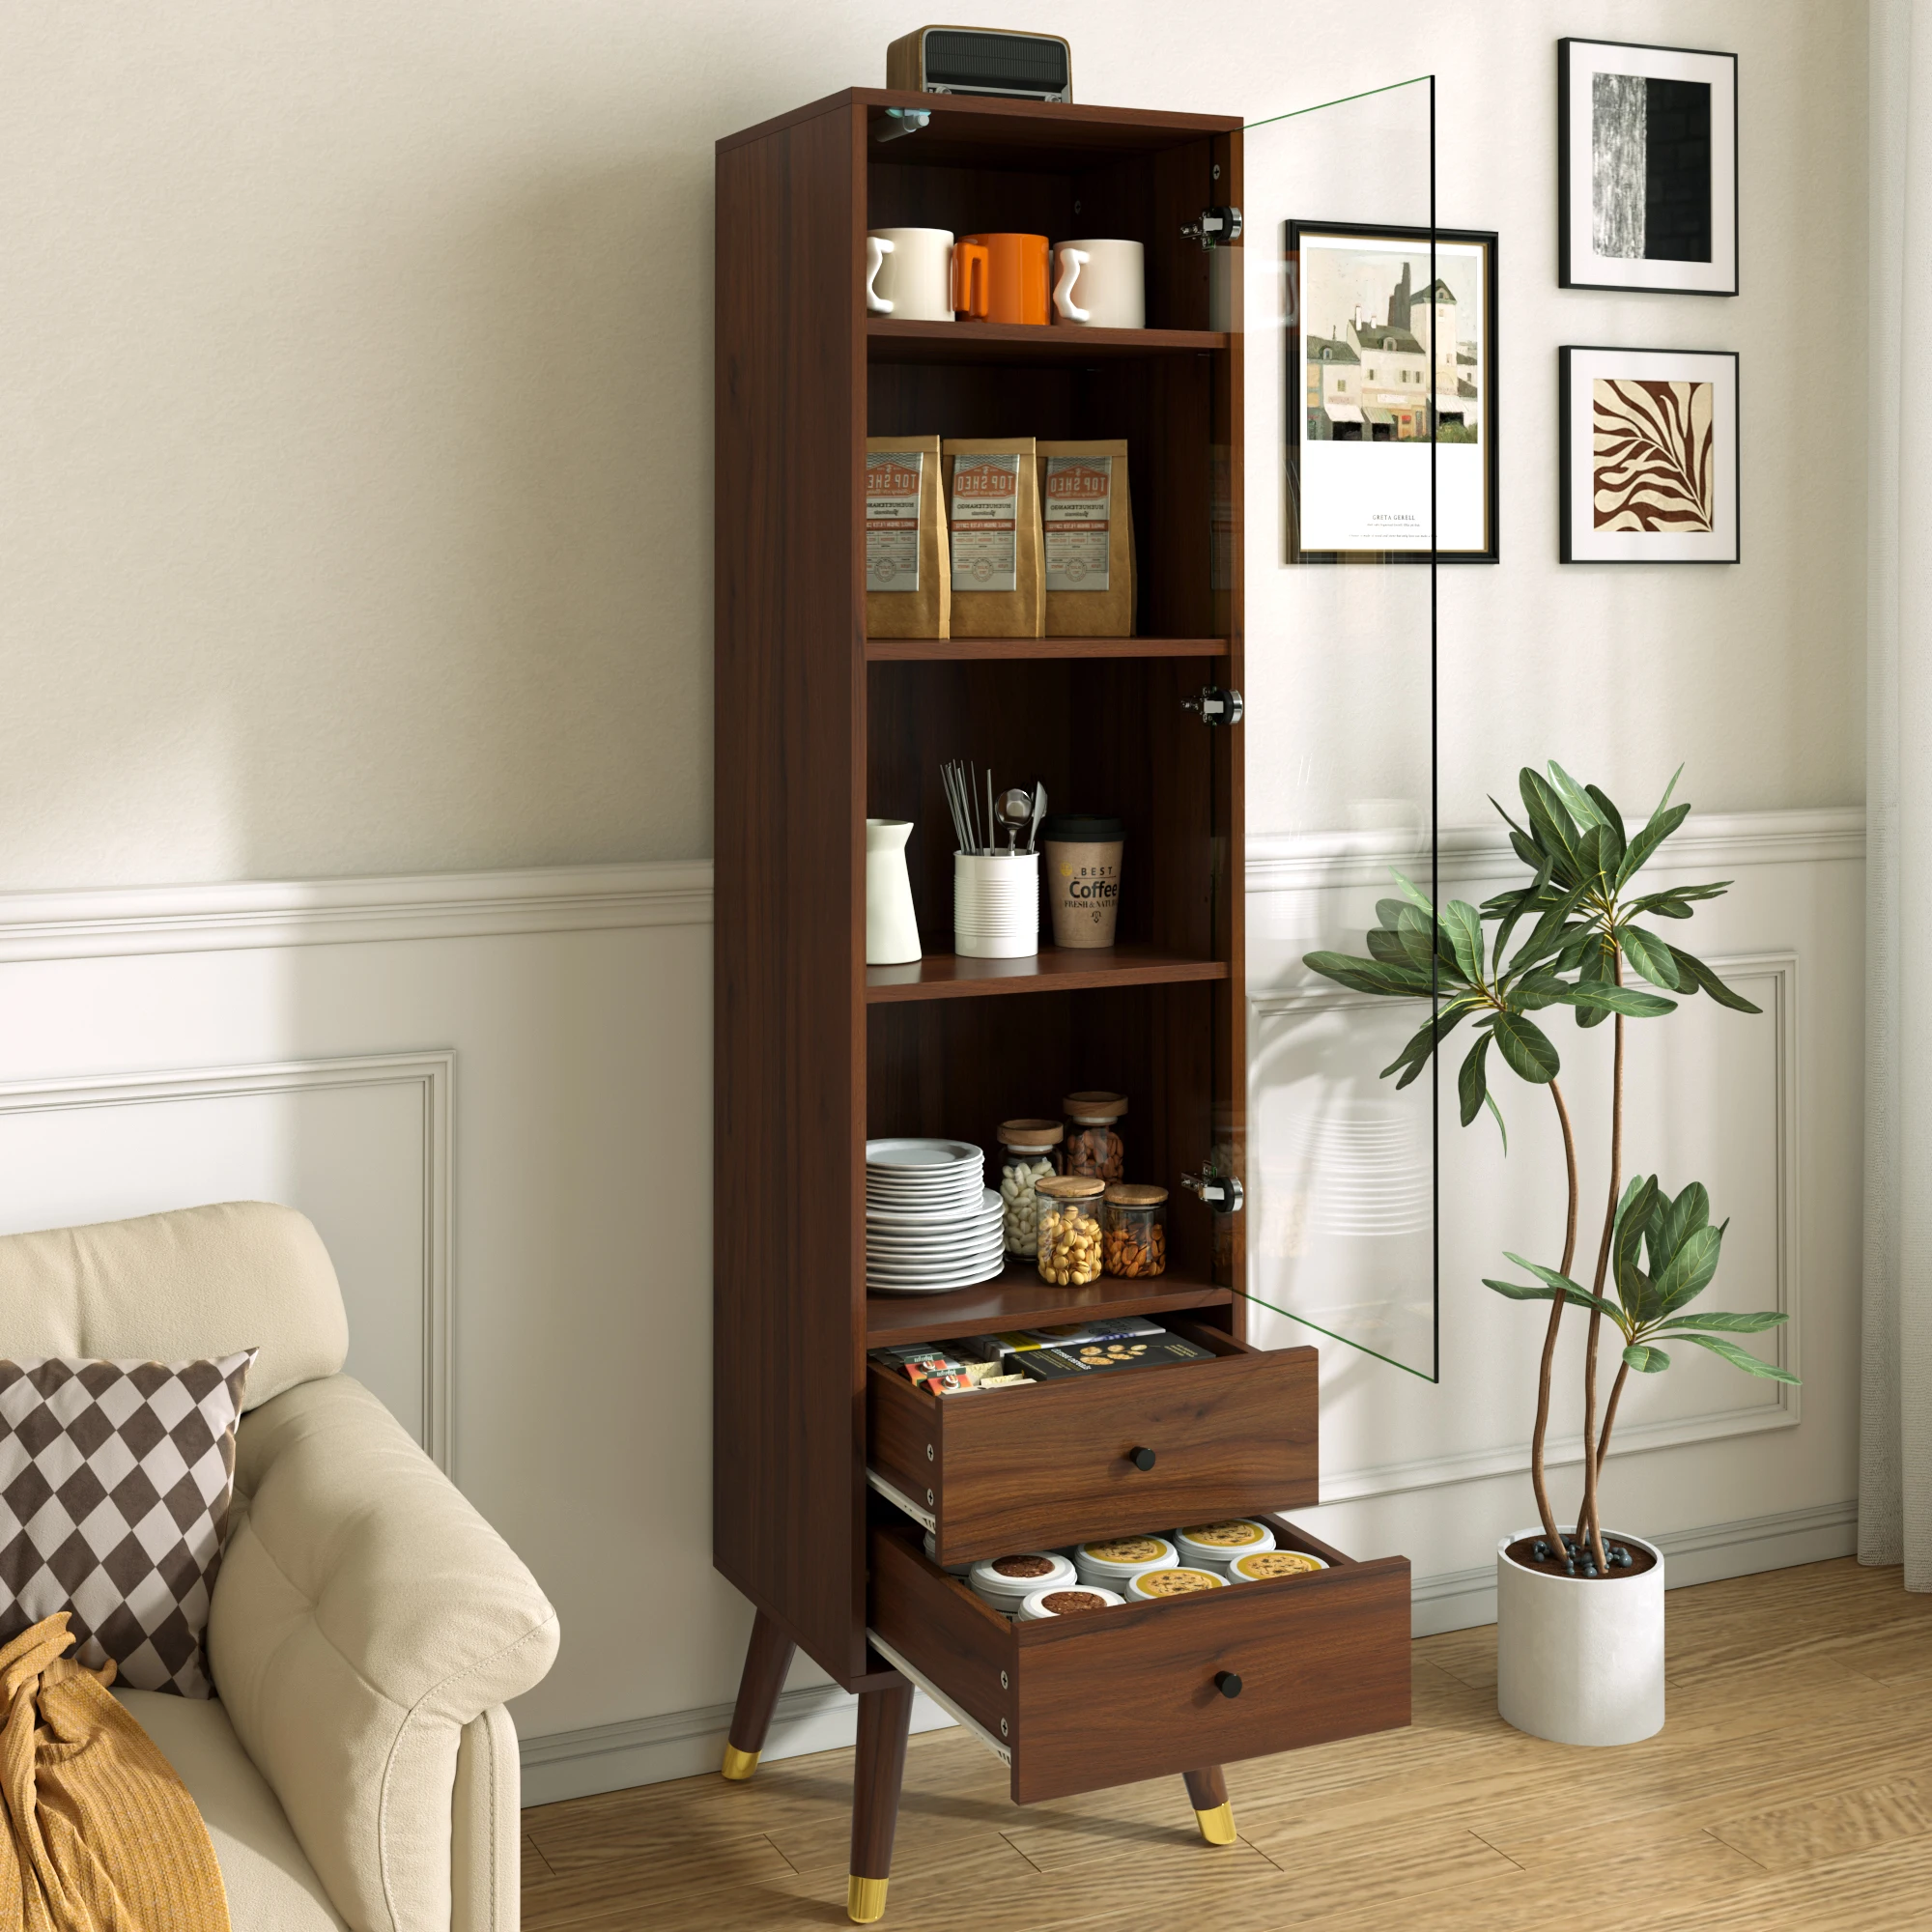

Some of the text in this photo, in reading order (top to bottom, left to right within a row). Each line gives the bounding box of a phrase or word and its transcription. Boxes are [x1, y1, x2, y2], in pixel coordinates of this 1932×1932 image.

[1081, 867, 1113, 876] BEST
[1069, 881, 1117, 898] Coffee
[1065, 899, 1088, 908] FRESH
